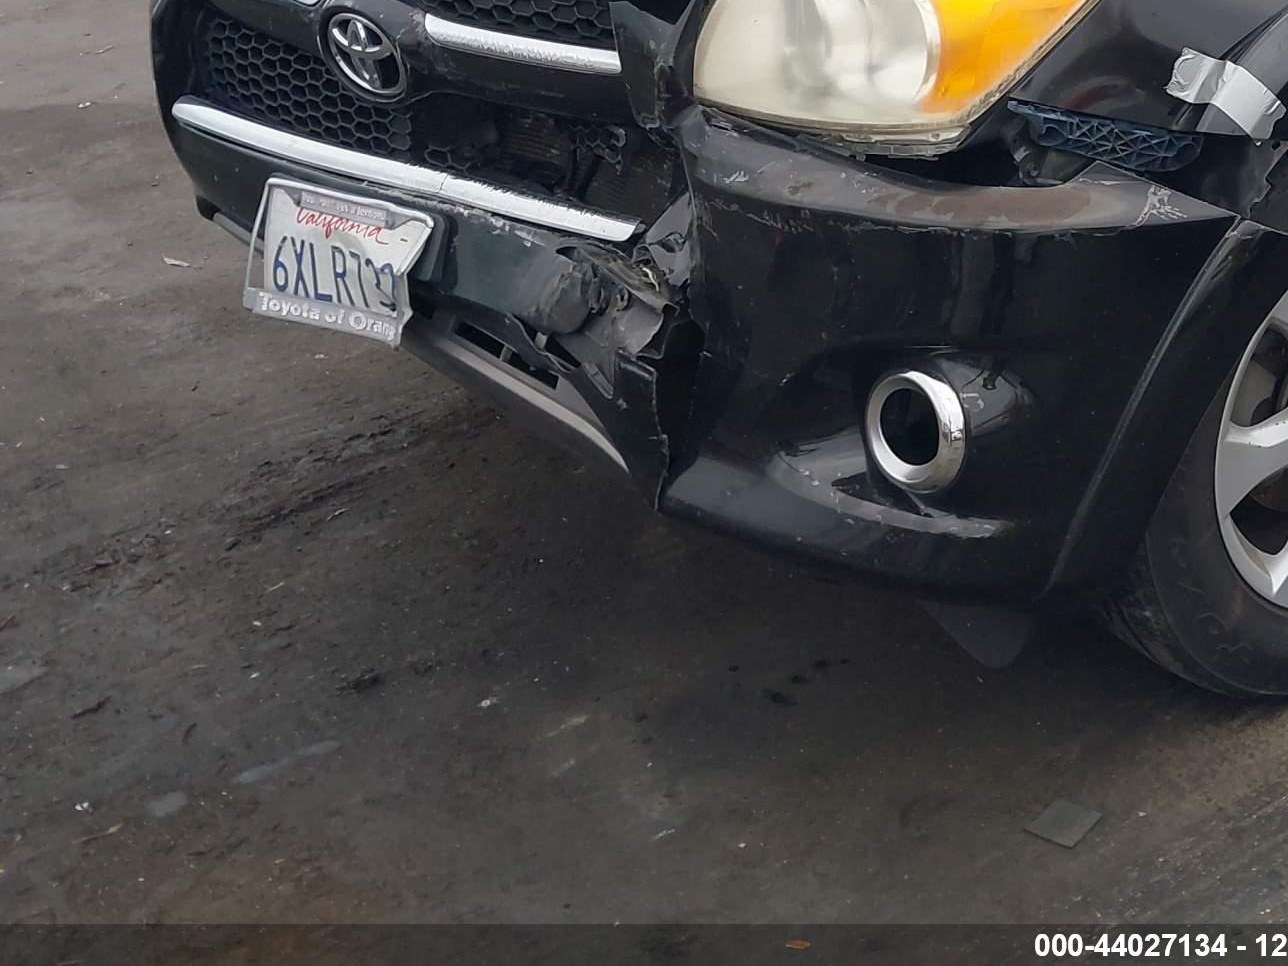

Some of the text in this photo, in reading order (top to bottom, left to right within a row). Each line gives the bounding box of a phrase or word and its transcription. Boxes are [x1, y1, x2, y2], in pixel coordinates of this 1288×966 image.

[259, 291, 397, 340] Toyota of Orang
